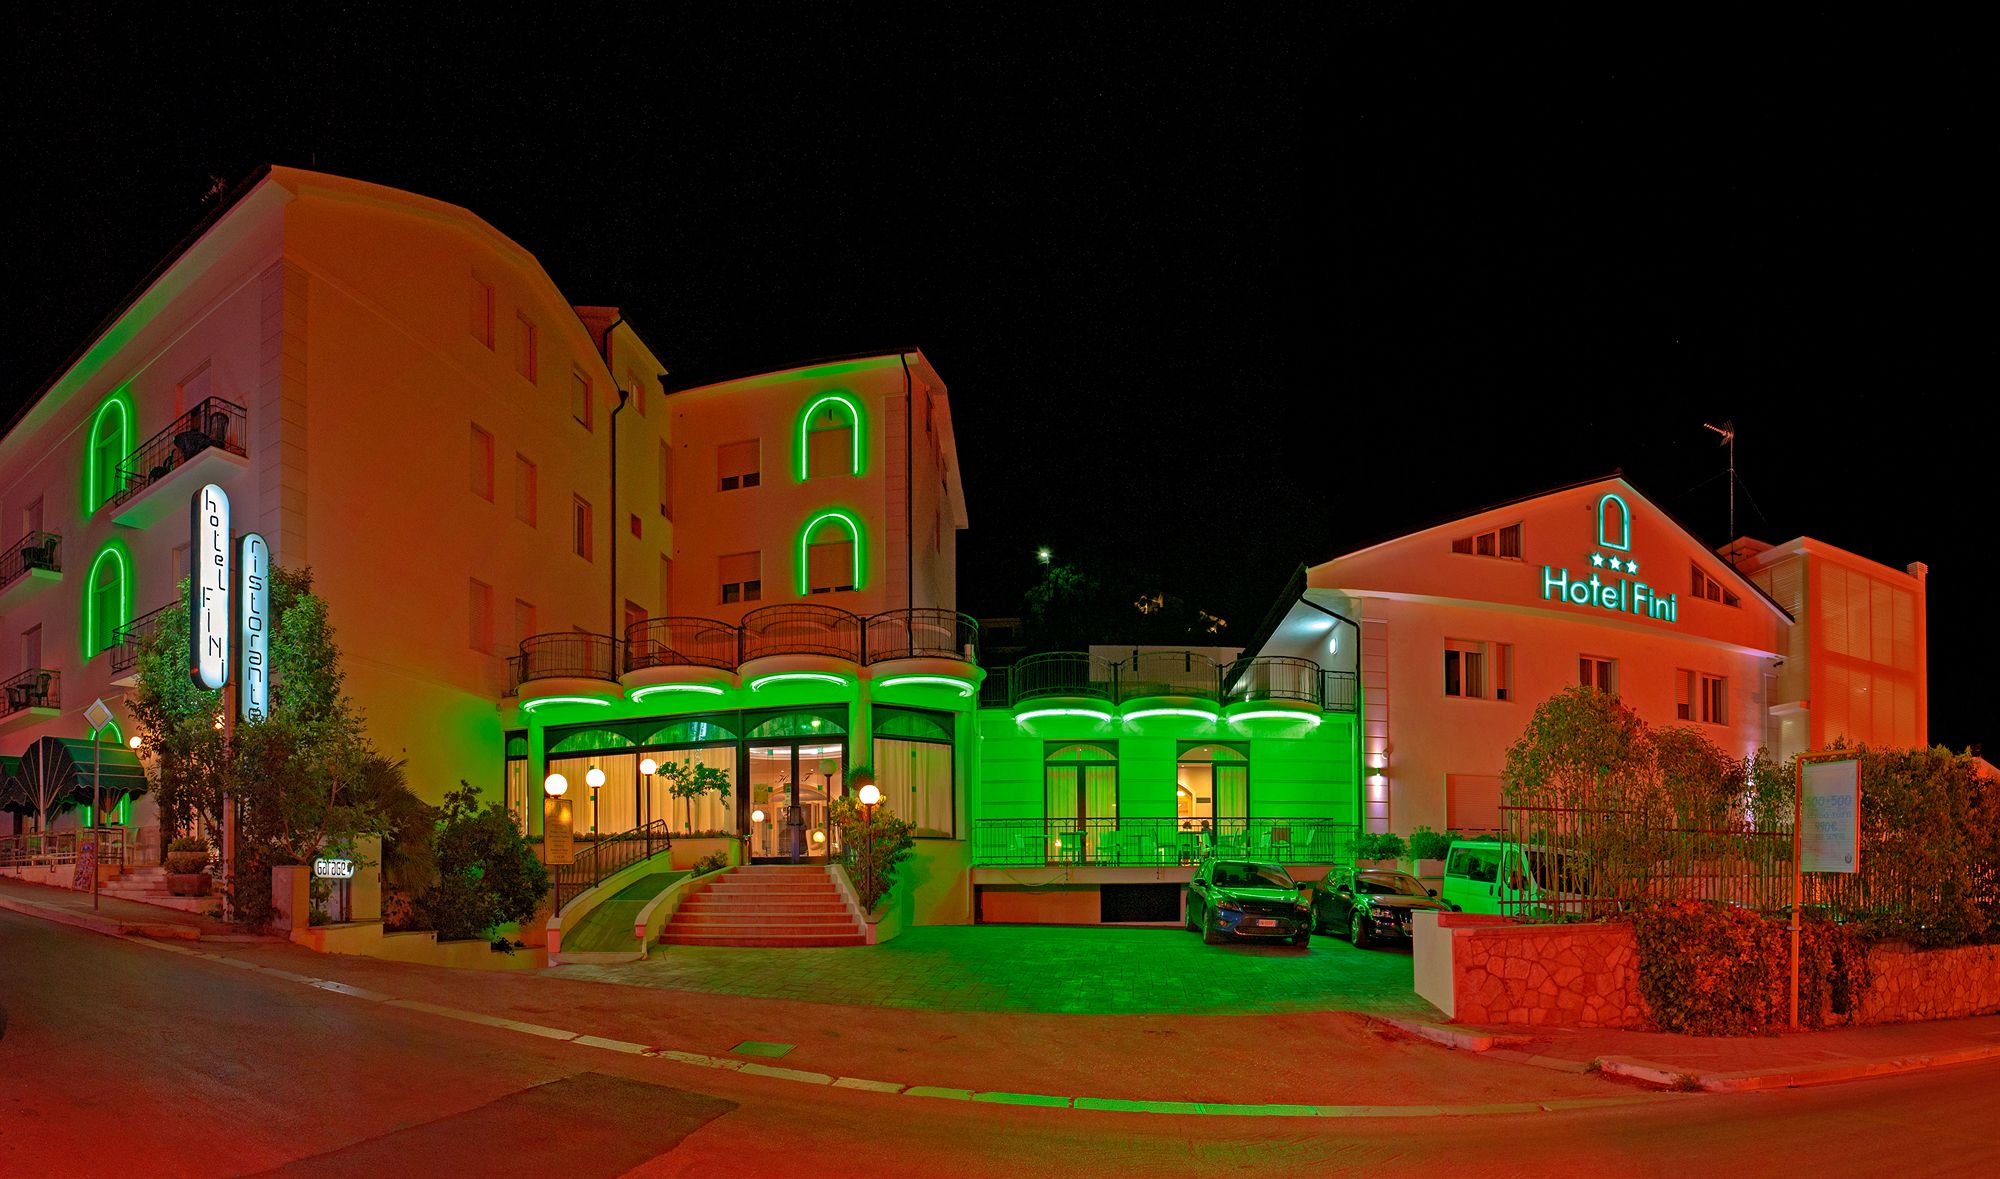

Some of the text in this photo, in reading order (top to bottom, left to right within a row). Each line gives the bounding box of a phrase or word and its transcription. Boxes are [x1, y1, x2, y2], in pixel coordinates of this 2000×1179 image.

[205, 489, 226, 591] hotel
[247, 539, 263, 722] ristorante
[1543, 565, 1676, 622] Hotel Fini
